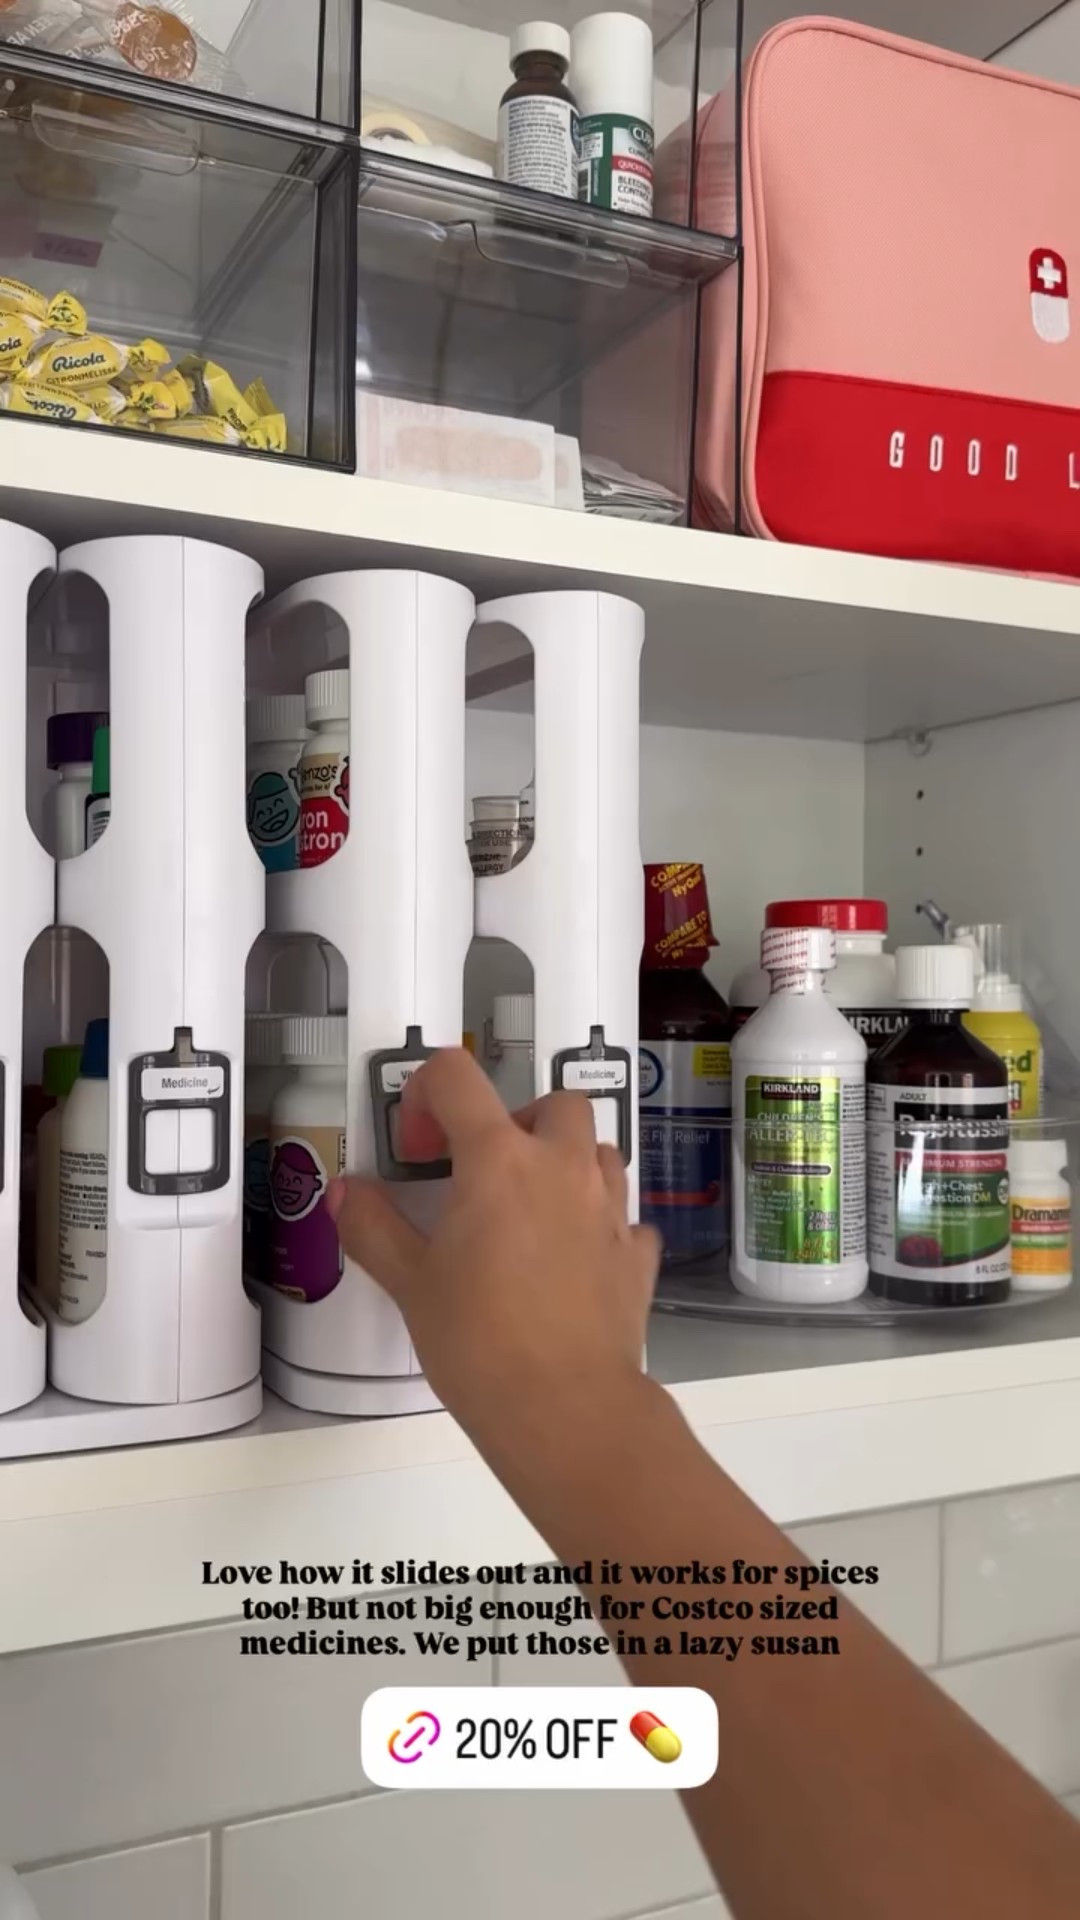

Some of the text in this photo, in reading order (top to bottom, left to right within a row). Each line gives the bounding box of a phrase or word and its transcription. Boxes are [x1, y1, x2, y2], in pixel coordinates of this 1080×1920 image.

[52, 352, 105, 372] Ricola
[889, 431, 1018, 481] GOOD
[579, 1069, 616, 1080] Medicine
[161, 1077, 209, 1089] Medicine
[763, 1083, 820, 1095] KIRKLAND
[900, 1093, 927, 1101] ADULT
[971, 1192, 991, 1203] DM
